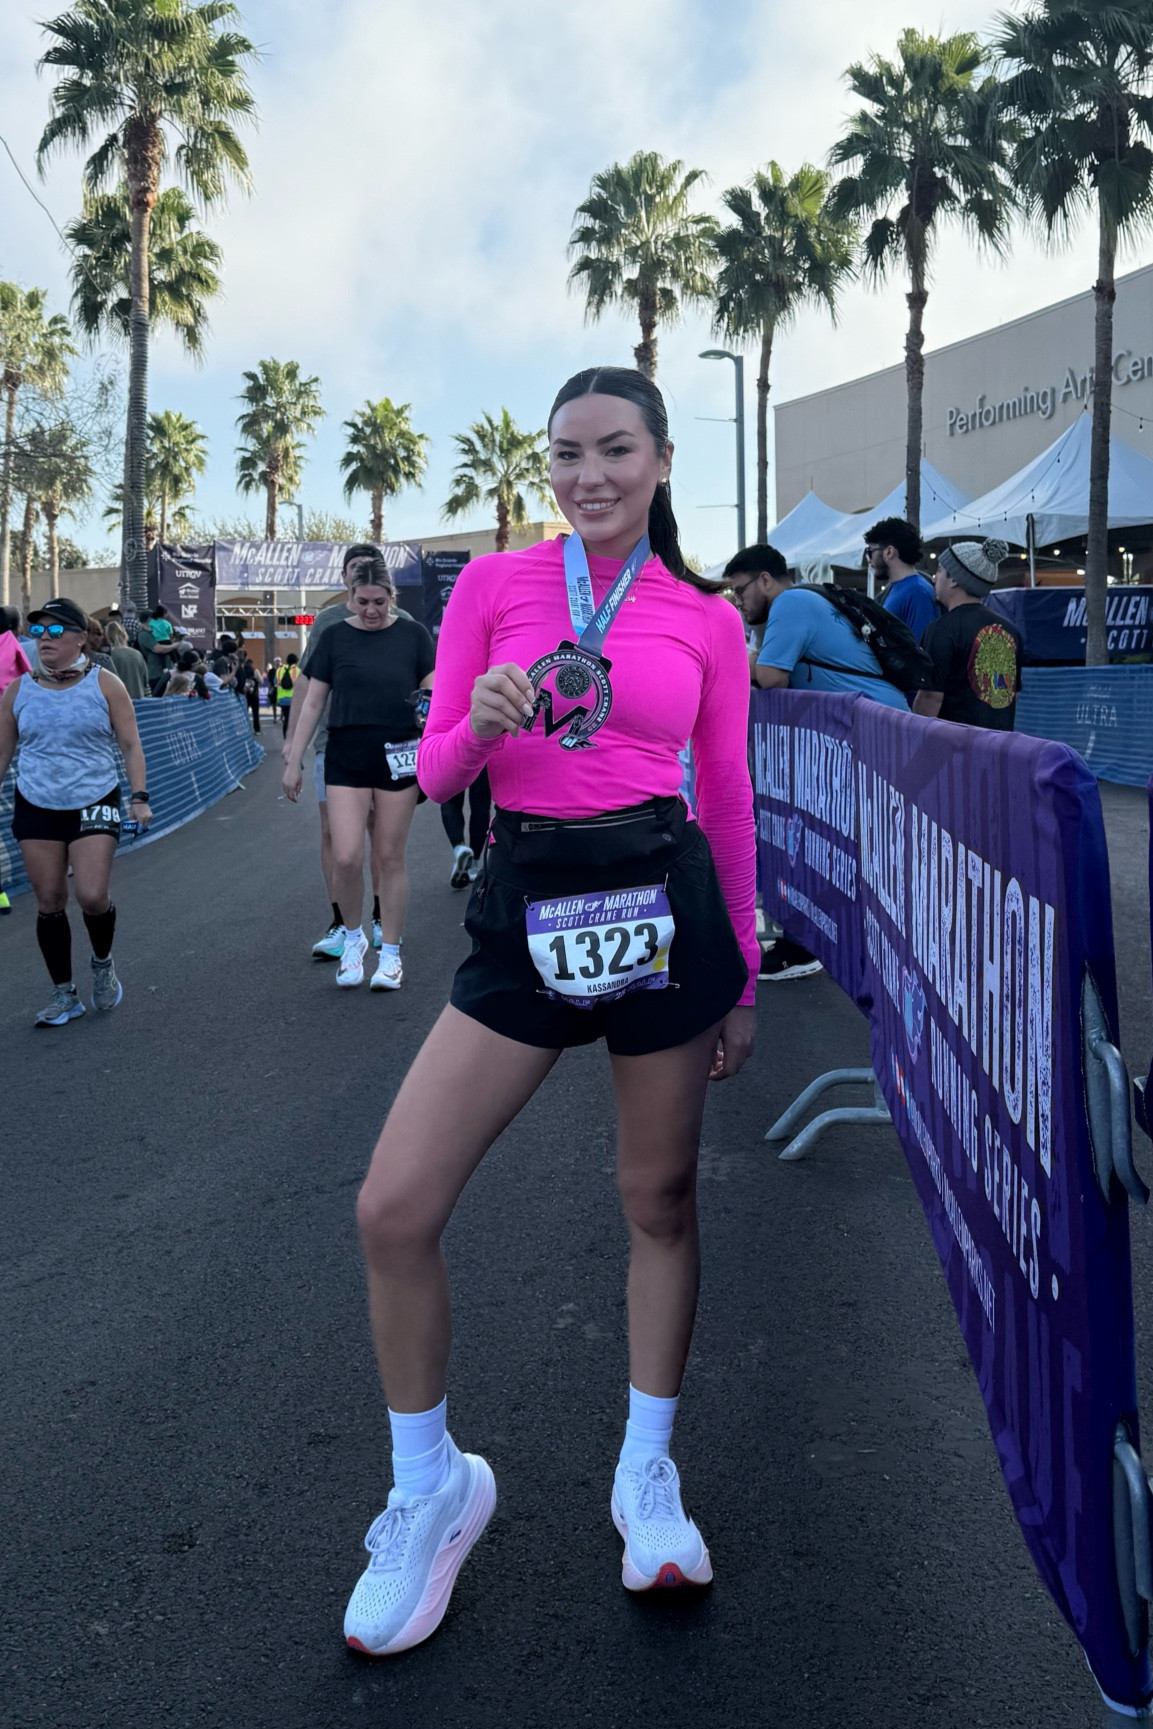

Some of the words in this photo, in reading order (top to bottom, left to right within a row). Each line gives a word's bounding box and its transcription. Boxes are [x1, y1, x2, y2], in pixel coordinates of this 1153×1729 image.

[946, 386, 1055, 437] Performing
[1060, 366, 1096, 403] Art
[229, 543, 302, 565] McALLEN
[255, 568, 300, 583] SCOTT
[595, 603, 611, 634] HALF
[608, 568, 632, 611] FINISHER
[1106, 629, 1148, 650] COTT
[553, 654, 596, 670] MARATHON
[596, 671, 609, 694] SCOTT
[1076, 703, 1118, 727] ULTRA
[754, 722, 790, 804] McALLEN
[832, 845, 857, 902] SERIES
[539, 899, 584, 920] McALLEN
[603, 888, 657, 911] MARATHON
[556, 916, 584, 928] SCOTT
[588, 910, 616, 925] CRANE
[621, 907, 639, 918] RUN
[548, 922, 659, 981] 1323
[858, 760, 906, 941] McALLEN
[911, 802, 1055, 1179] MARATHON
[587, 977, 629, 994] KASSANDRA
[930, 1015, 978, 1174] RUNNING
[984, 1113, 1041, 1299] SERIES
